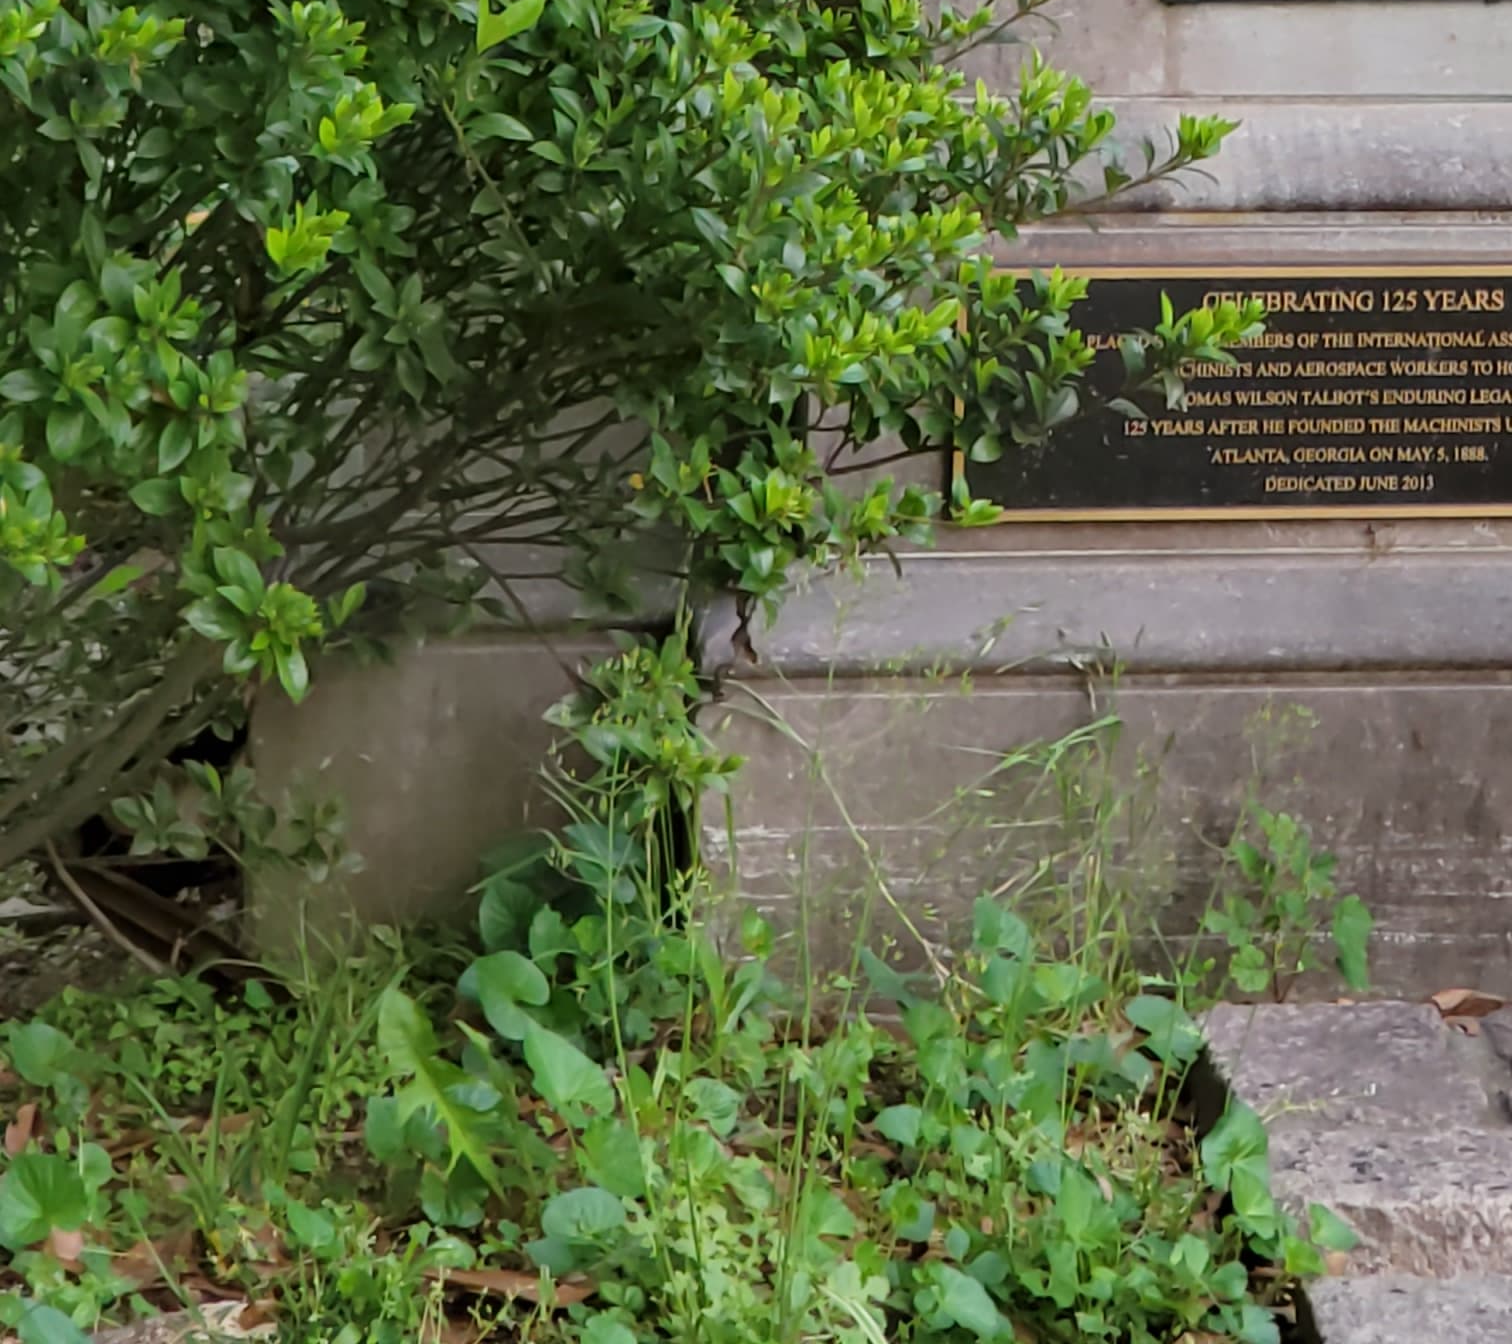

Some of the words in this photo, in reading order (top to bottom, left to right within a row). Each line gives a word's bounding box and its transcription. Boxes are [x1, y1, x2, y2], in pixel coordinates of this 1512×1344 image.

[1381, 290, 1417, 311] 125
[1422, 290, 1504, 311] YEARS
[1087, 332, 1154, 349] PLAD
[1210, 332, 1294, 349] EMBERS
[1298, 332, 1318, 349] OF
[1322, 332, 1354, 349] THE
[1357, 332, 1485, 349] INTERNATIONAL
[1160, 360, 1252, 377] CHINISTS
[1257, 360, 1290, 377] AND
[1295, 360, 1386, 377] AEROSPACE
[1390, 360, 1469, 377] WORKERS
[1471, 360, 1493, 377] TO
[1169, 389, 1230, 406] OMAS
[1235, 389, 1297, 406] WILSON
[1384, 389, 1467, 406] ENDURING
[1123, 418, 1148, 435] 125
[1151, 418, 1204, 435] YEARS
[1207, 418, 1259, 435] AFTER
[1262, 418, 1285, 435] HE
[1289, 418, 1366, 435] FOUNDED
[1369, 418, 1400, 435] THE
[1404, 418, 1501, 435] MACHINISTS
[1211, 446, 1289, 464] ATLANTA,
[1293, 446, 1366, 464] GEORGIA
[1370, 446, 1394, 464] ON
[1397, 446, 1433, 464] MAY
[1265, 475, 1356, 492] DEDICATED
[1359, 475, 1397, 492] JUNE
[1401, 475, 1434, 492] 2013
